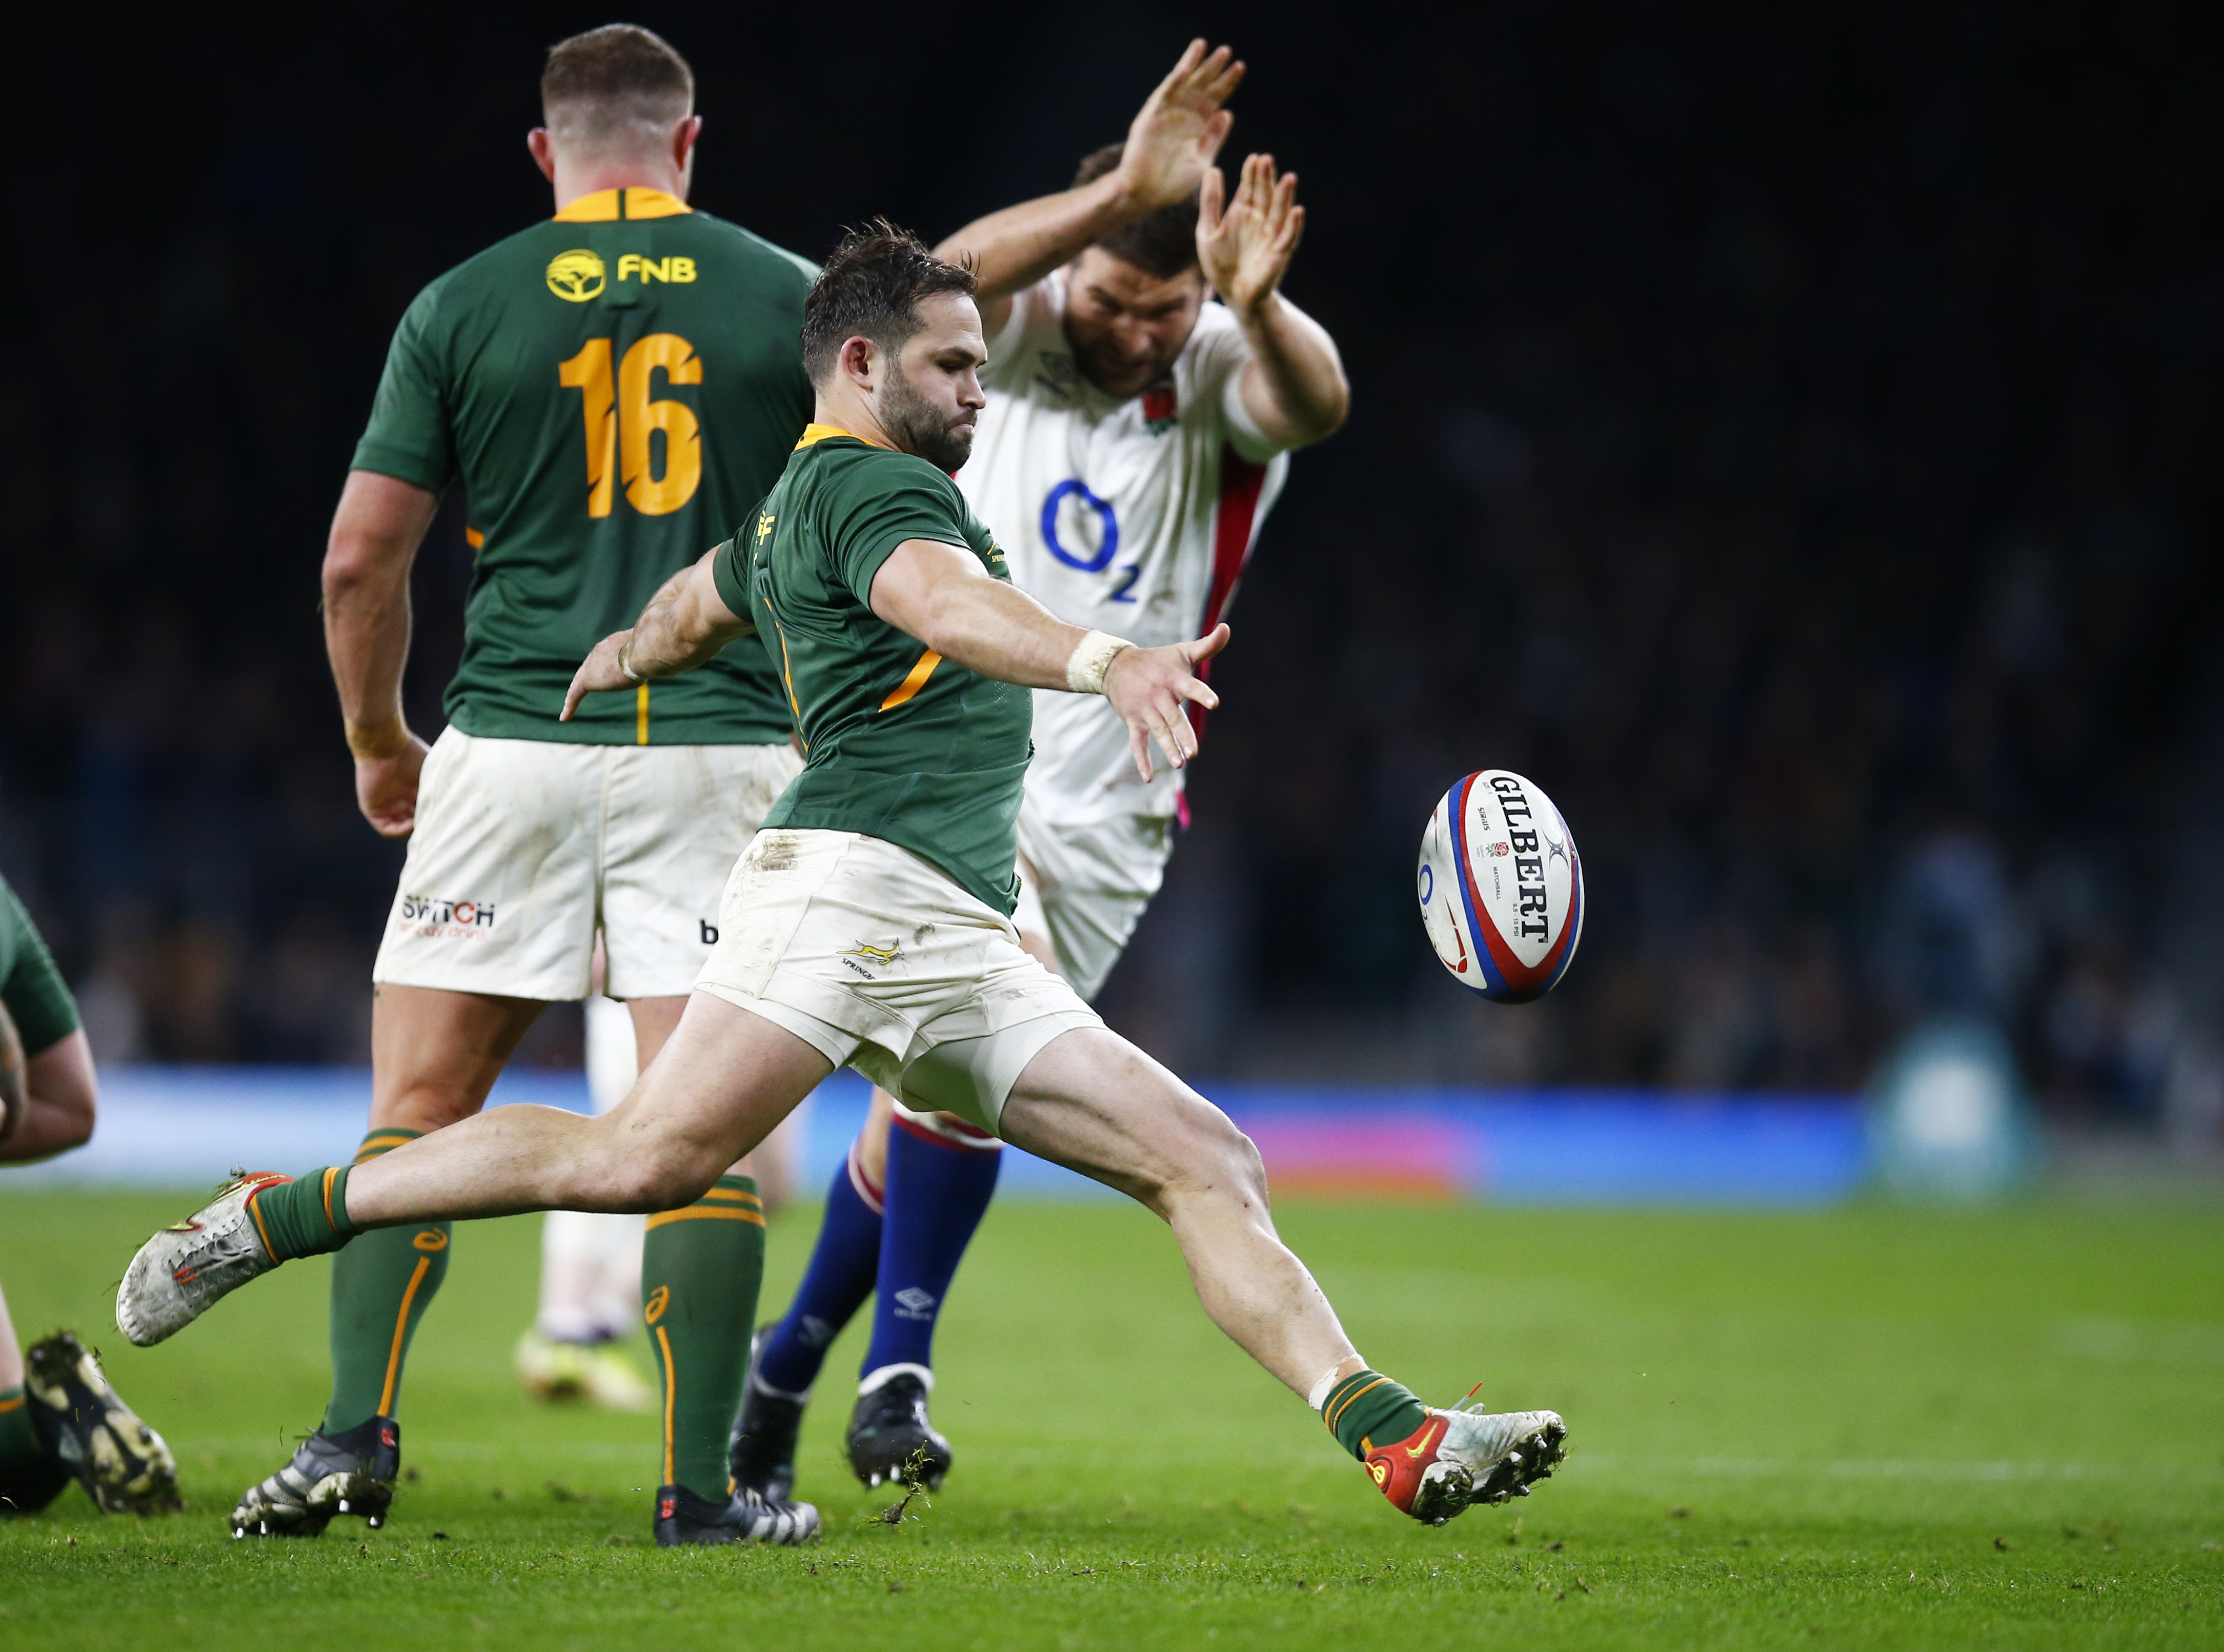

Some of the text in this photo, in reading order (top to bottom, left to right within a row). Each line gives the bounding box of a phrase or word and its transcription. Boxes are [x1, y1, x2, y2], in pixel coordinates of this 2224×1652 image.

[618, 254, 698, 285] FNB
[559, 333, 703, 518] 16
[1490, 777, 1548, 943] GILBERT
